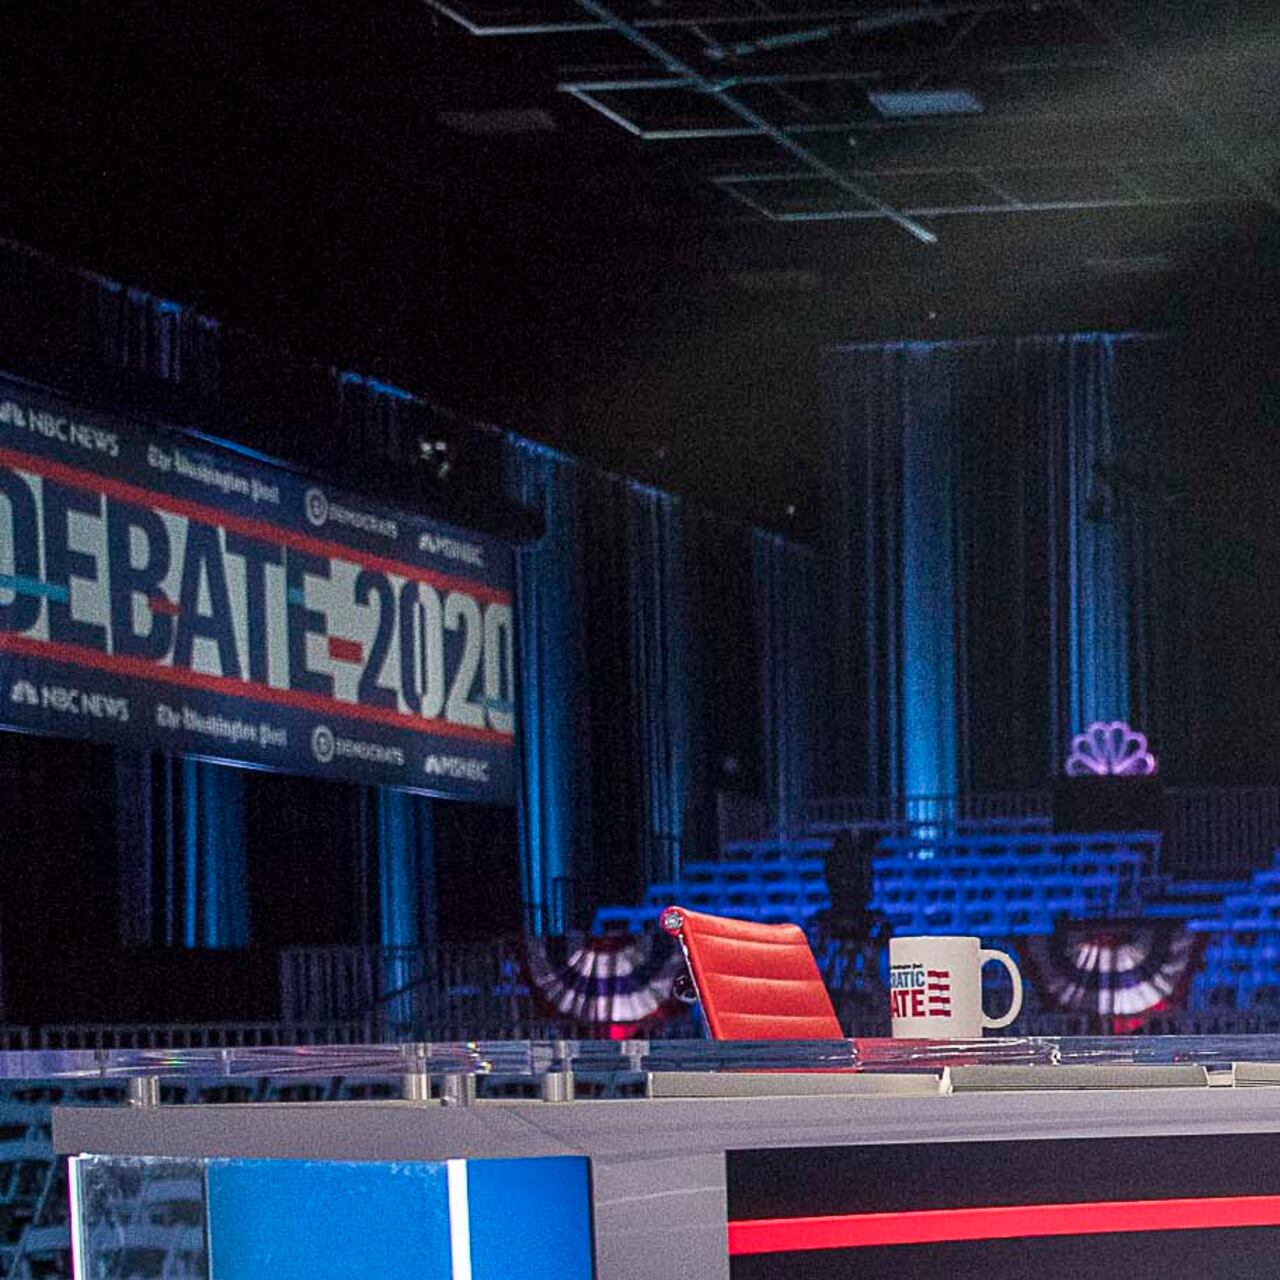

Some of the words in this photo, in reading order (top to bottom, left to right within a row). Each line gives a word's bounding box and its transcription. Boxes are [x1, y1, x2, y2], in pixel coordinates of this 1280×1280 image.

[29, 408, 68, 443] NBC
[70, 421, 119, 458] NEWS
[0, 468, 335, 701] DEBATE
[355, 566, 515, 732] 2020
[41, 685, 79, 714] NBC
